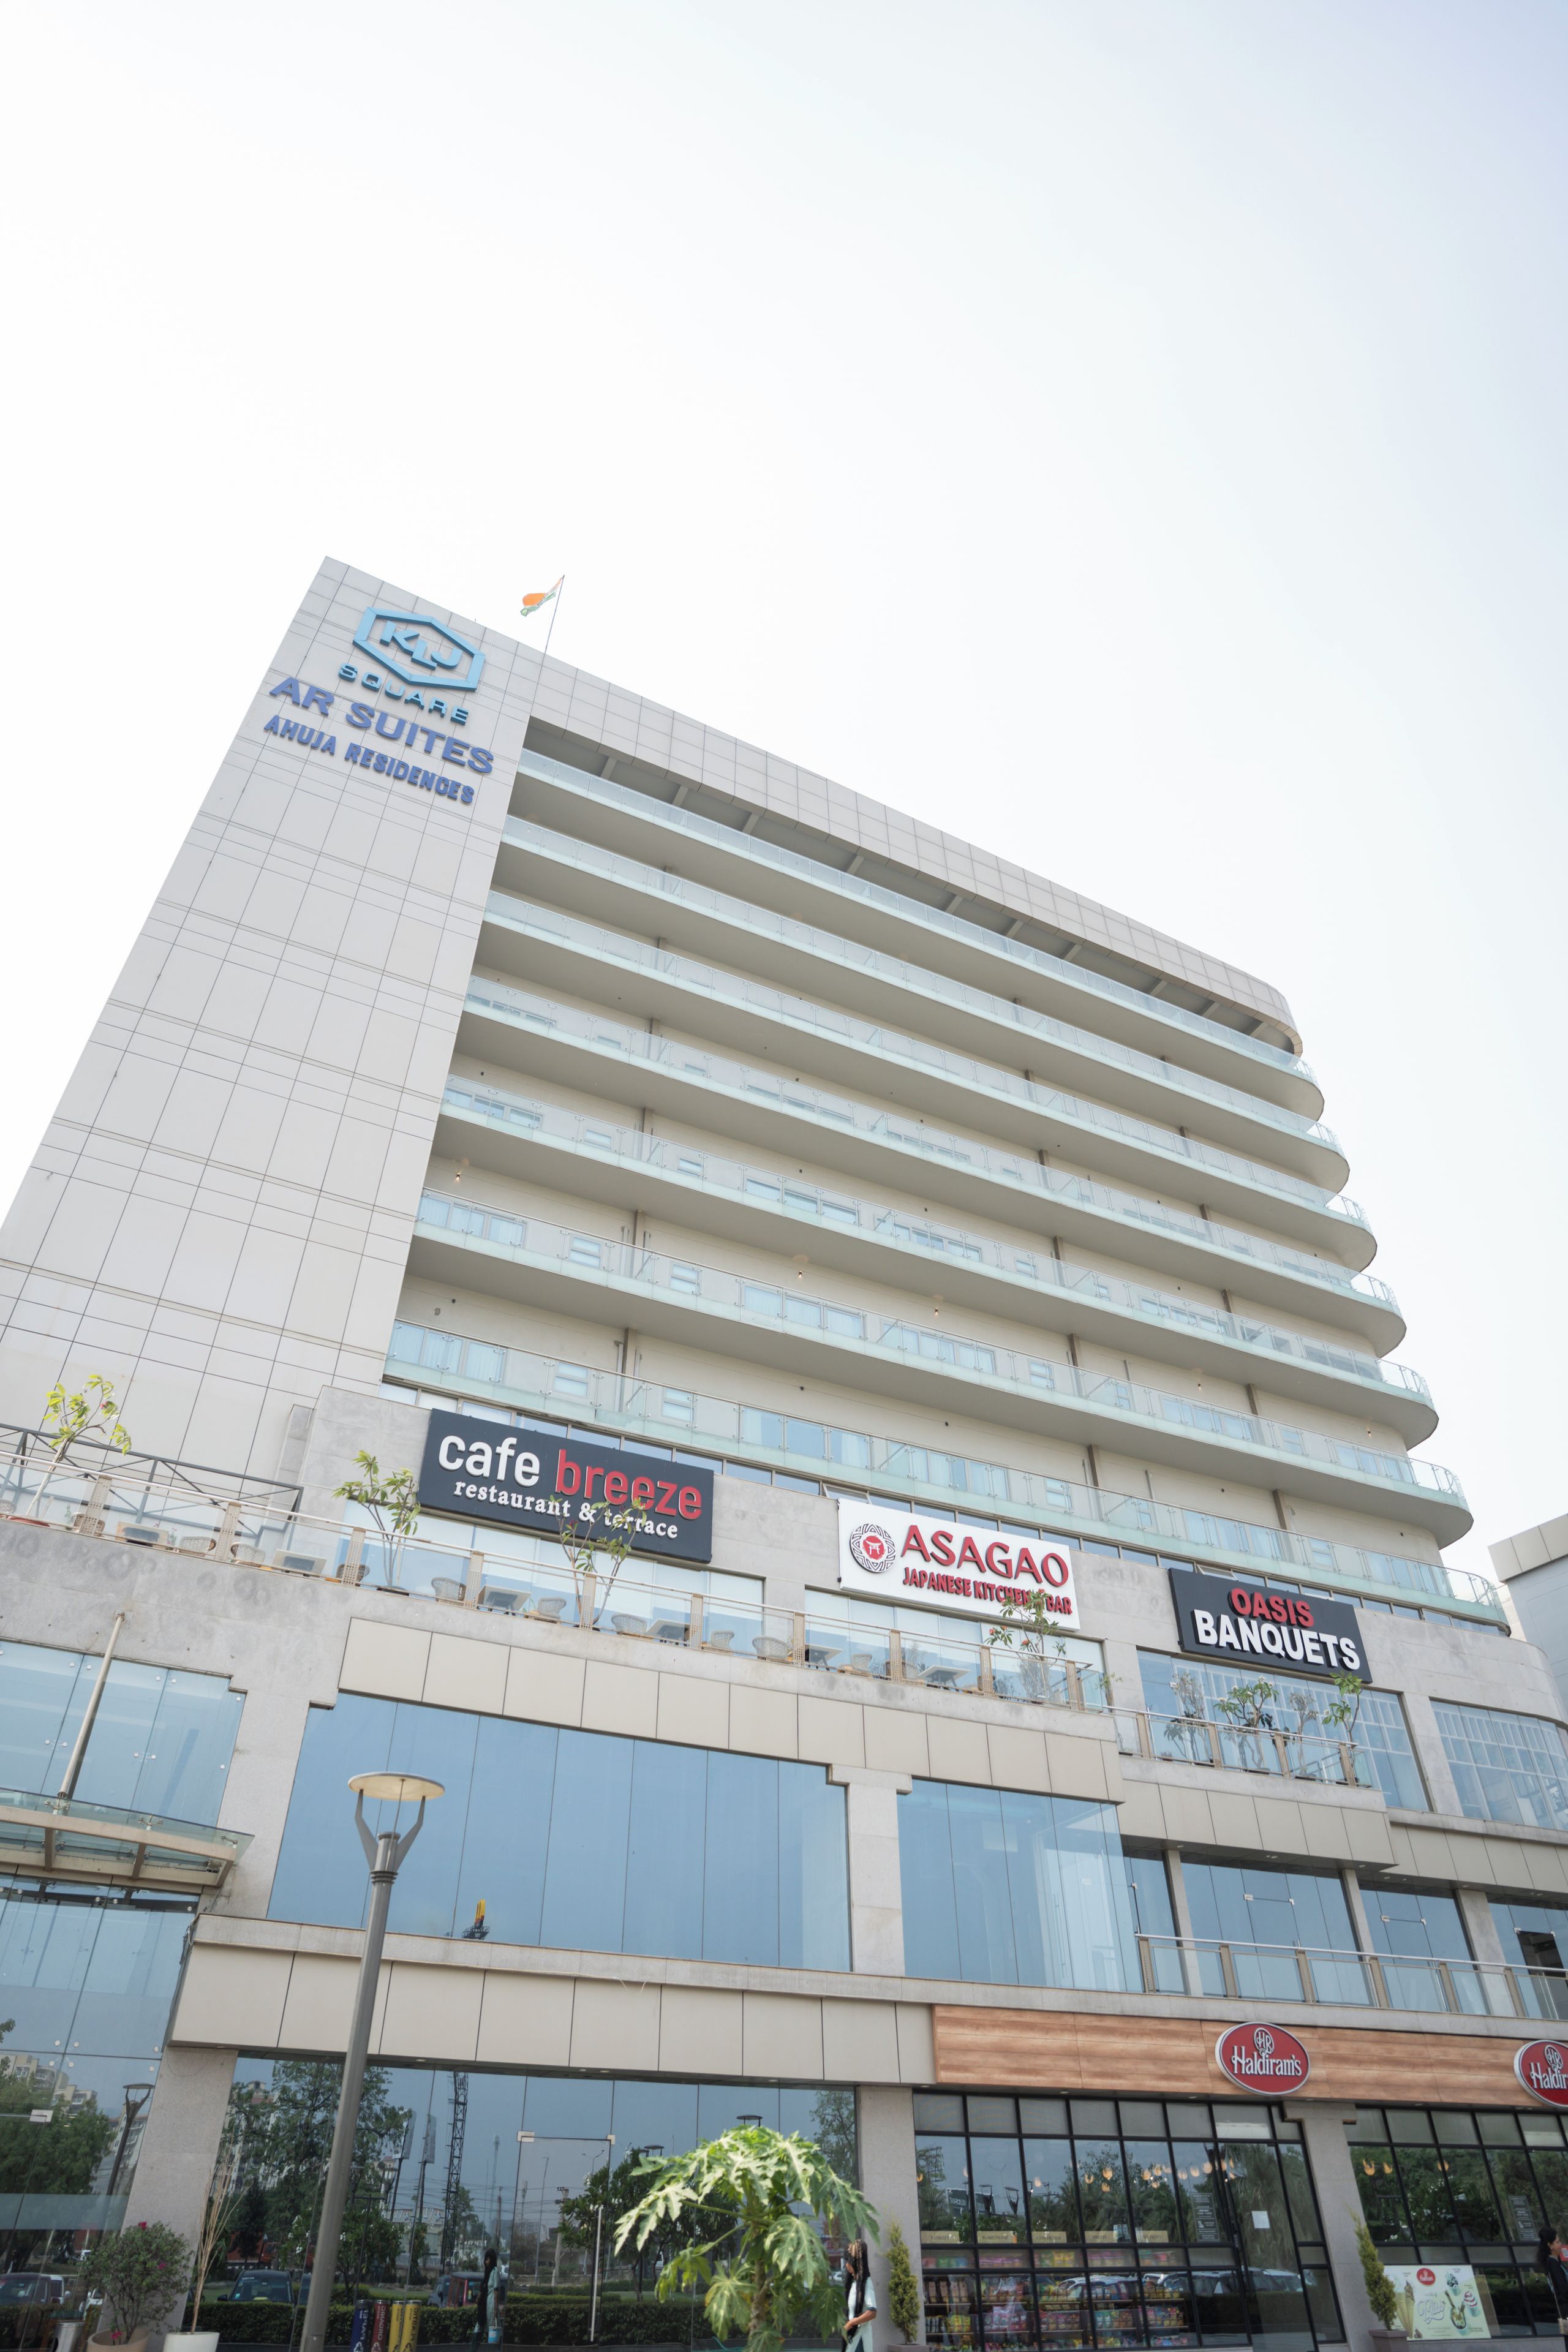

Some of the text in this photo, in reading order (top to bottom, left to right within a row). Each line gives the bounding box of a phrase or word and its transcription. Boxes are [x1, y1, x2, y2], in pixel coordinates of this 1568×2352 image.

[380, 620, 463, 671] KLJ
[338, 663, 470, 725] SQUARE
[270, 677, 494, 774] AR SUITES
[263, 715, 475, 804] AHUJA RESIDENCES
[439, 1435, 702, 1520] cafe breeze
[453, 1480, 678, 1539] restaurant & terrace
[901, 1525, 1069, 1587] ASAGAO
[903, 1567, 1073, 1615] JAPANESE KITCHEN BAR
[1229, 1588, 1314, 1627] OASIS
[1193, 1609, 1360, 1670] BANQUETS
[1231, 2046, 1302, 2076] Haldiram's
